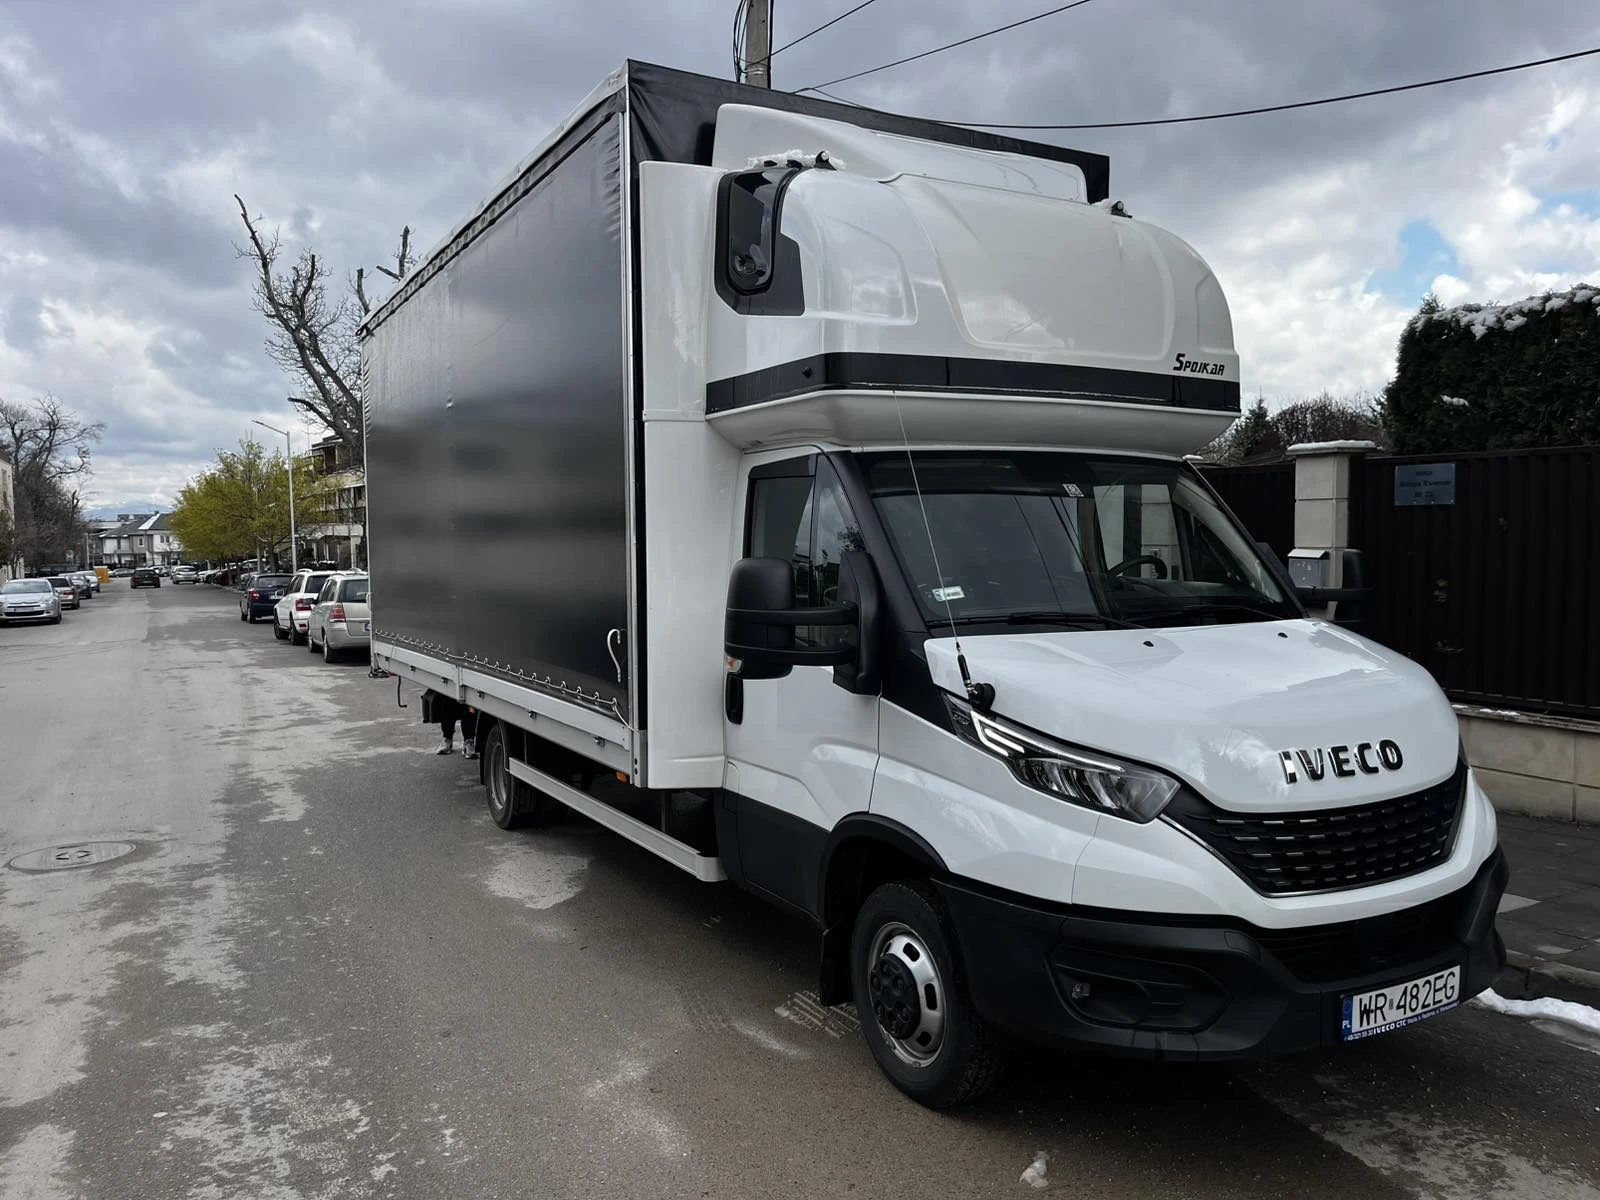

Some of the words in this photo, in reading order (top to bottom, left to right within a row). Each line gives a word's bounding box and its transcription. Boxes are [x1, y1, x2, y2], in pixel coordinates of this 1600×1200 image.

[1278, 739, 1403, 784] IVECO
[1359, 993, 1387, 1028] WR
[1395, 971, 1456, 1015] 482EG
[1342, 1019, 1351, 1030] PL
[1373, 1023, 1395, 1035] IVECO
[1396, 1019, 1407, 1029] CTC
